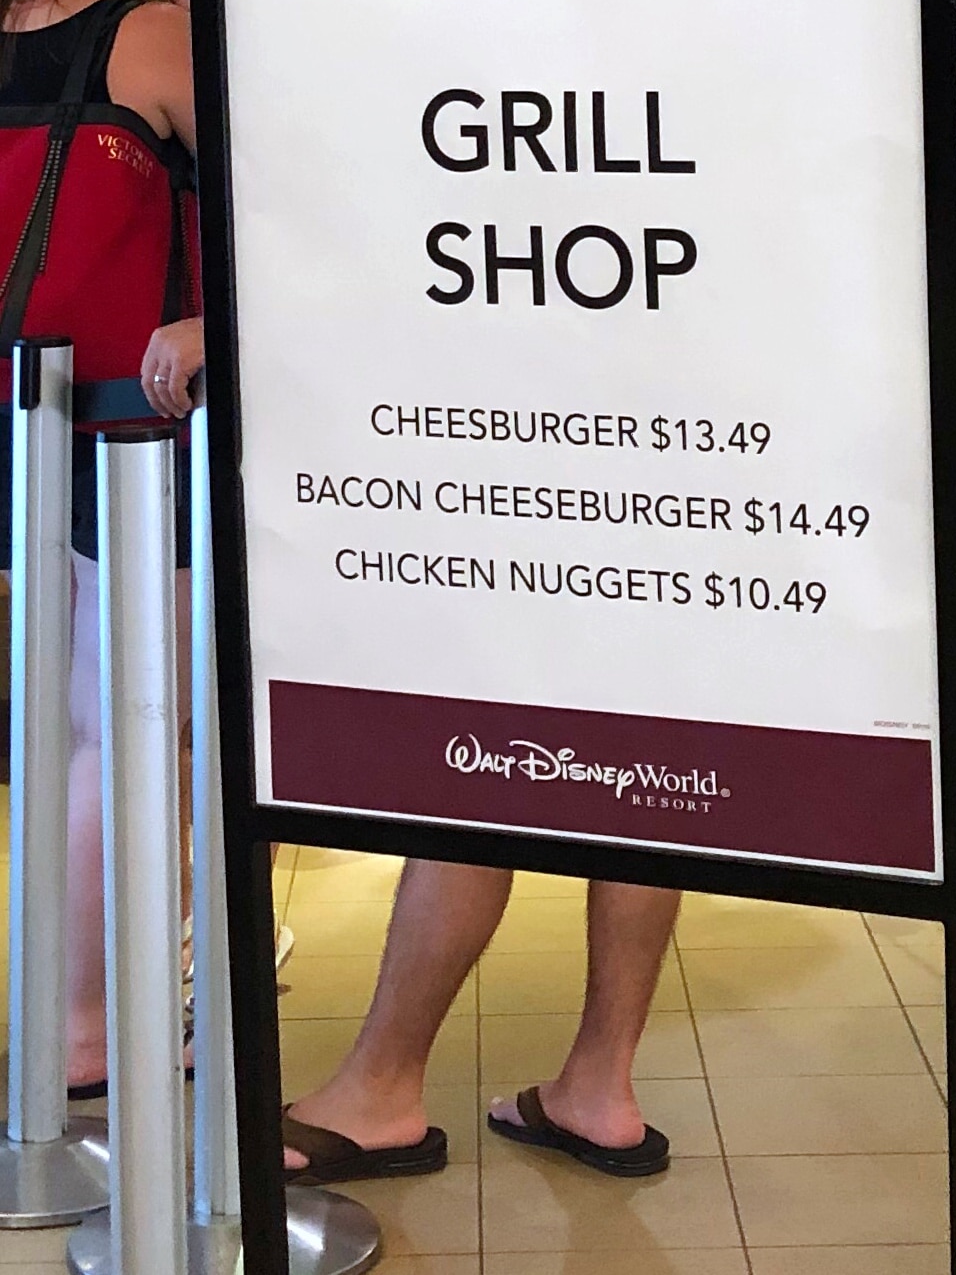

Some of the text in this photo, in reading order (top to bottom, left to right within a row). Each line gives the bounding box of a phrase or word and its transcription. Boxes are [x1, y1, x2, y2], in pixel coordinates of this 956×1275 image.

[421, 88, 696, 174] GRILL
[425, 221, 698, 310] SHOP
[371, 404, 771, 455] CHEESBURGER $13.49
[296, 472, 870, 538] BACON CHEESEBURGER $14.49
[335, 548, 827, 614] CHICKEN NUGGETS $10.49
[631, 793, 712, 814] RESORT
